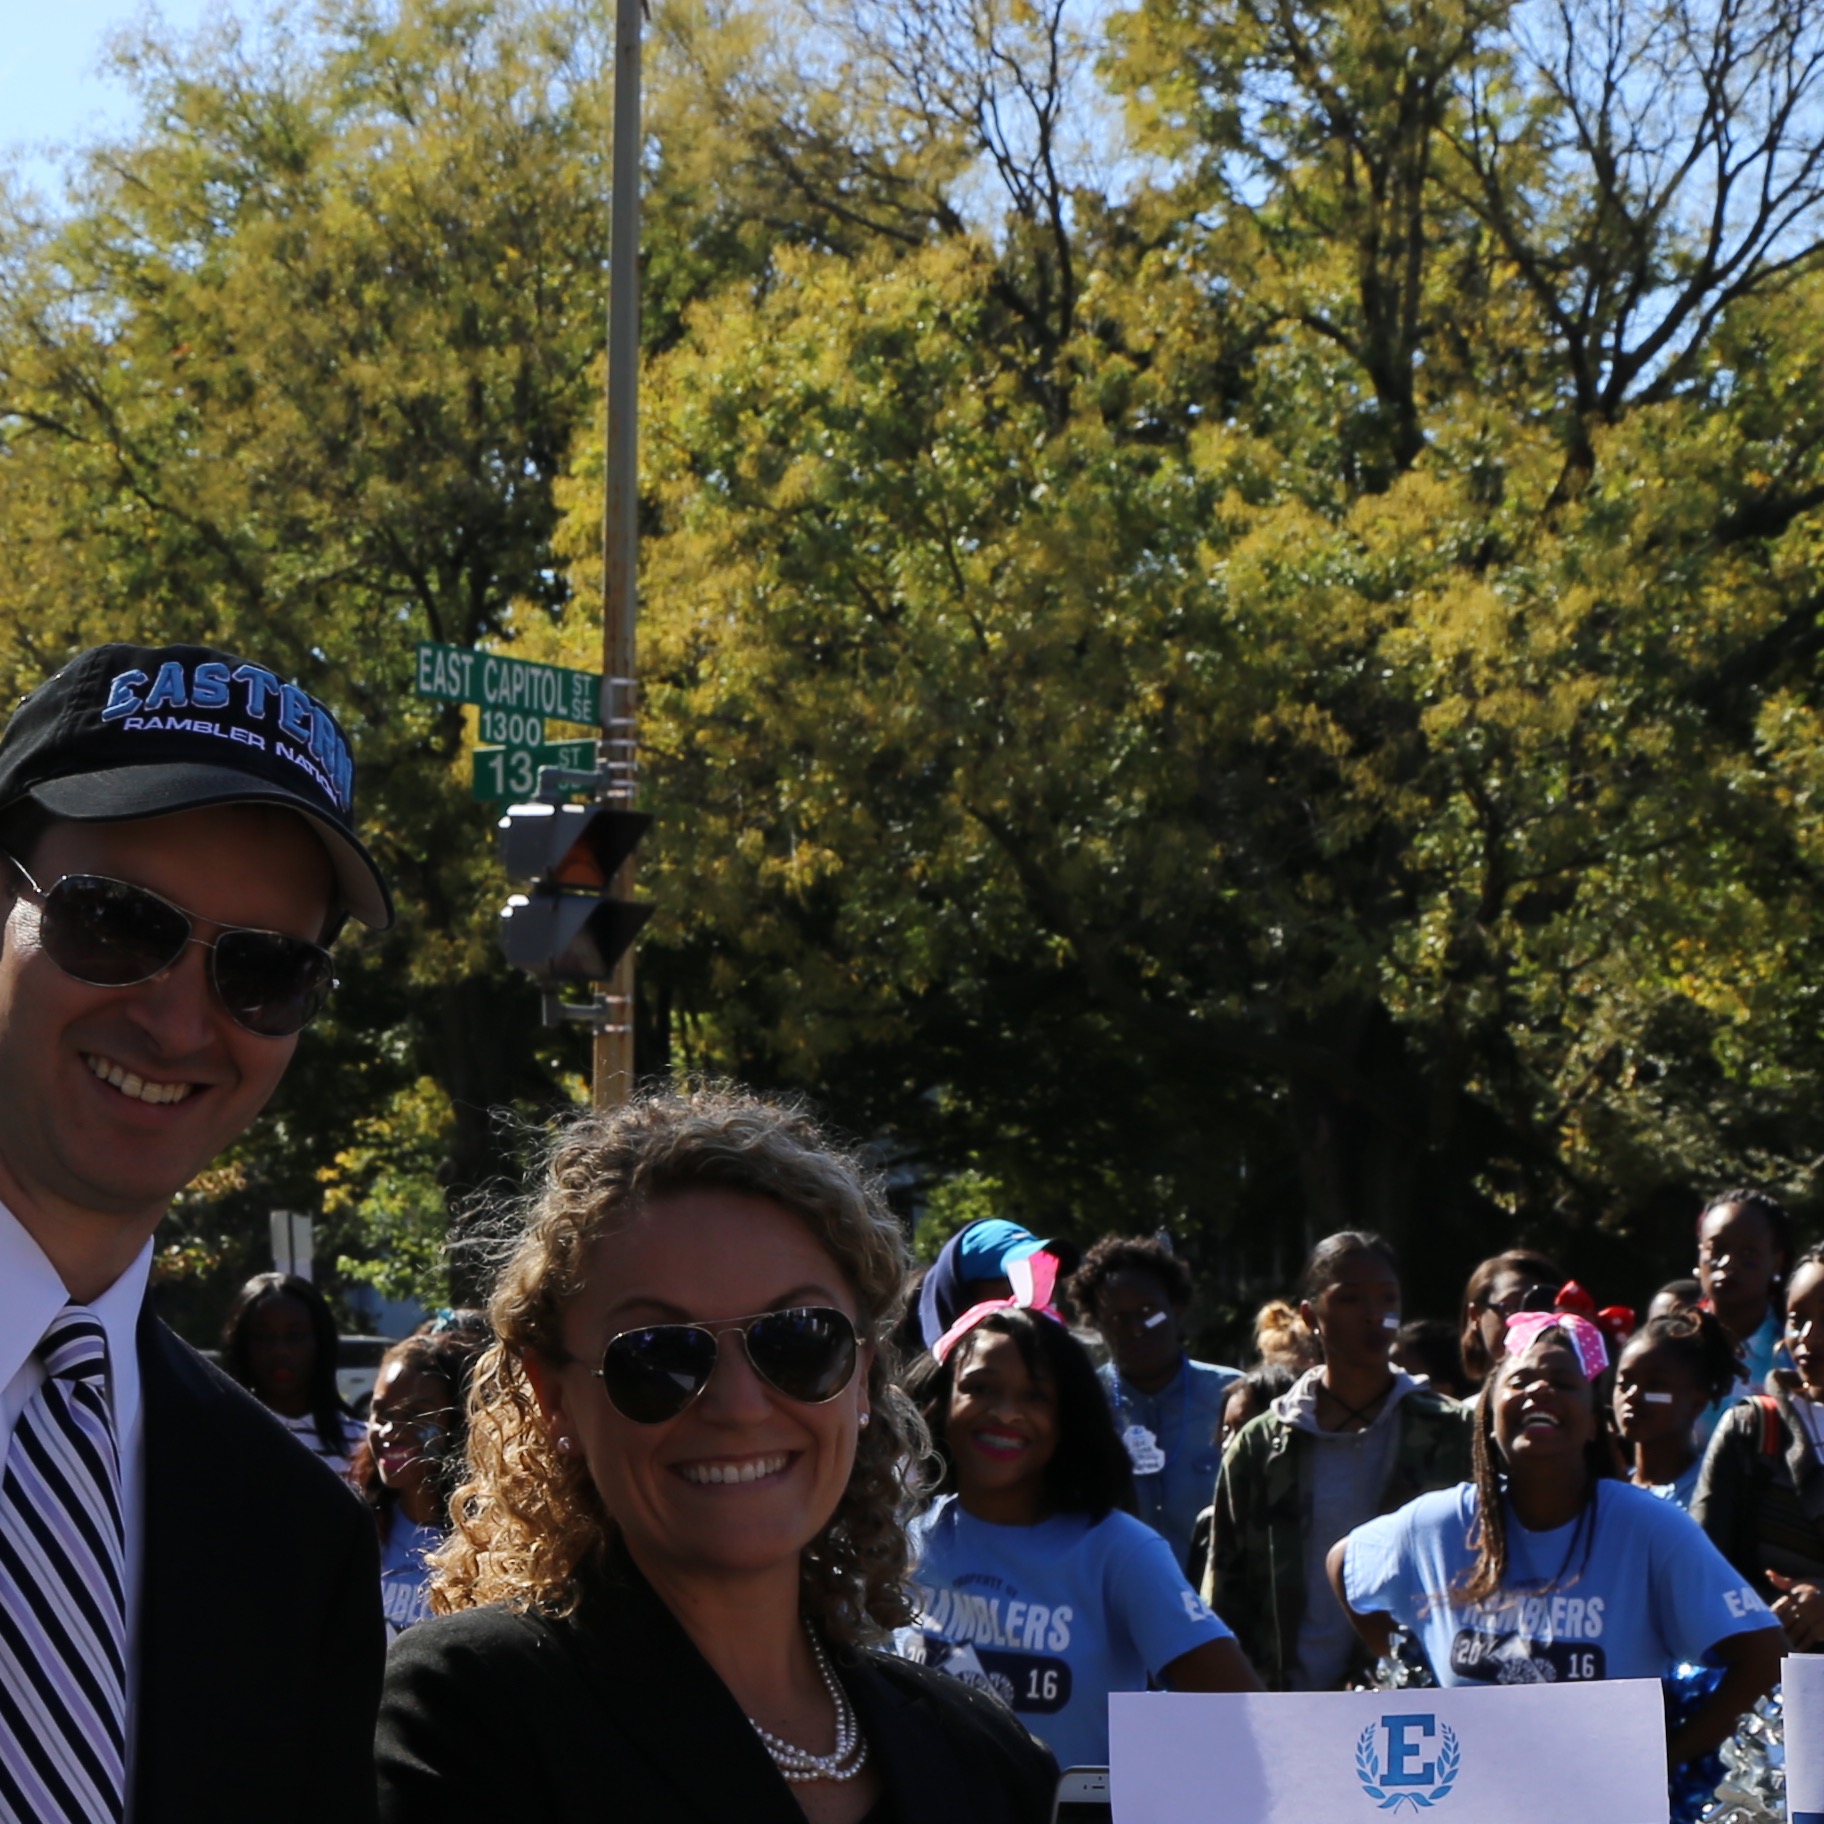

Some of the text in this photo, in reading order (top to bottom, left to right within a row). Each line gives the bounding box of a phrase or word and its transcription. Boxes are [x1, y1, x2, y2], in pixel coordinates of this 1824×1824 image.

[419, 647, 592, 715] EAST CAPITOL ST
[572, 700, 592, 721] SE
[123, 717, 265, 750] RAMBLER
[483, 710, 541, 747] 1300
[489, 748, 581, 794] 13 ST
[1567, 1653, 1594, 1678] 16
[1026, 1669, 1058, 1700] 16
[1380, 1713, 1436, 1787] E
